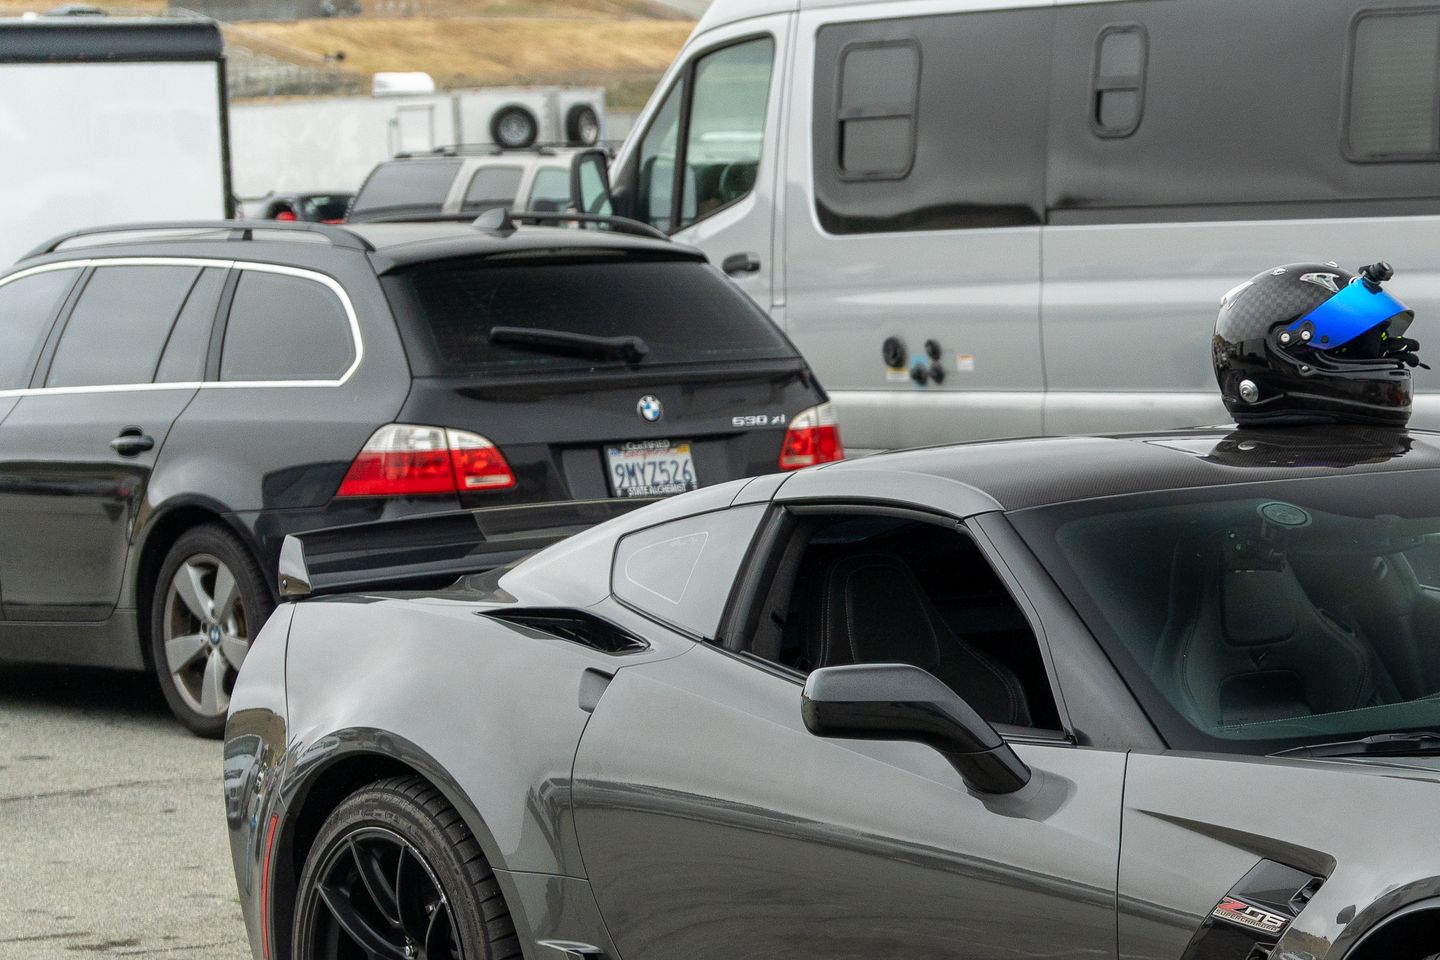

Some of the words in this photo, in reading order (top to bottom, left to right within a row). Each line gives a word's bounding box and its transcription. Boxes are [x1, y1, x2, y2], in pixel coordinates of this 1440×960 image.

[615, 459, 693, 488] 9MYZ526
[1215, 909, 1278, 931] SUPERCHARGED
[1217, 896, 1287, 928] Z06
